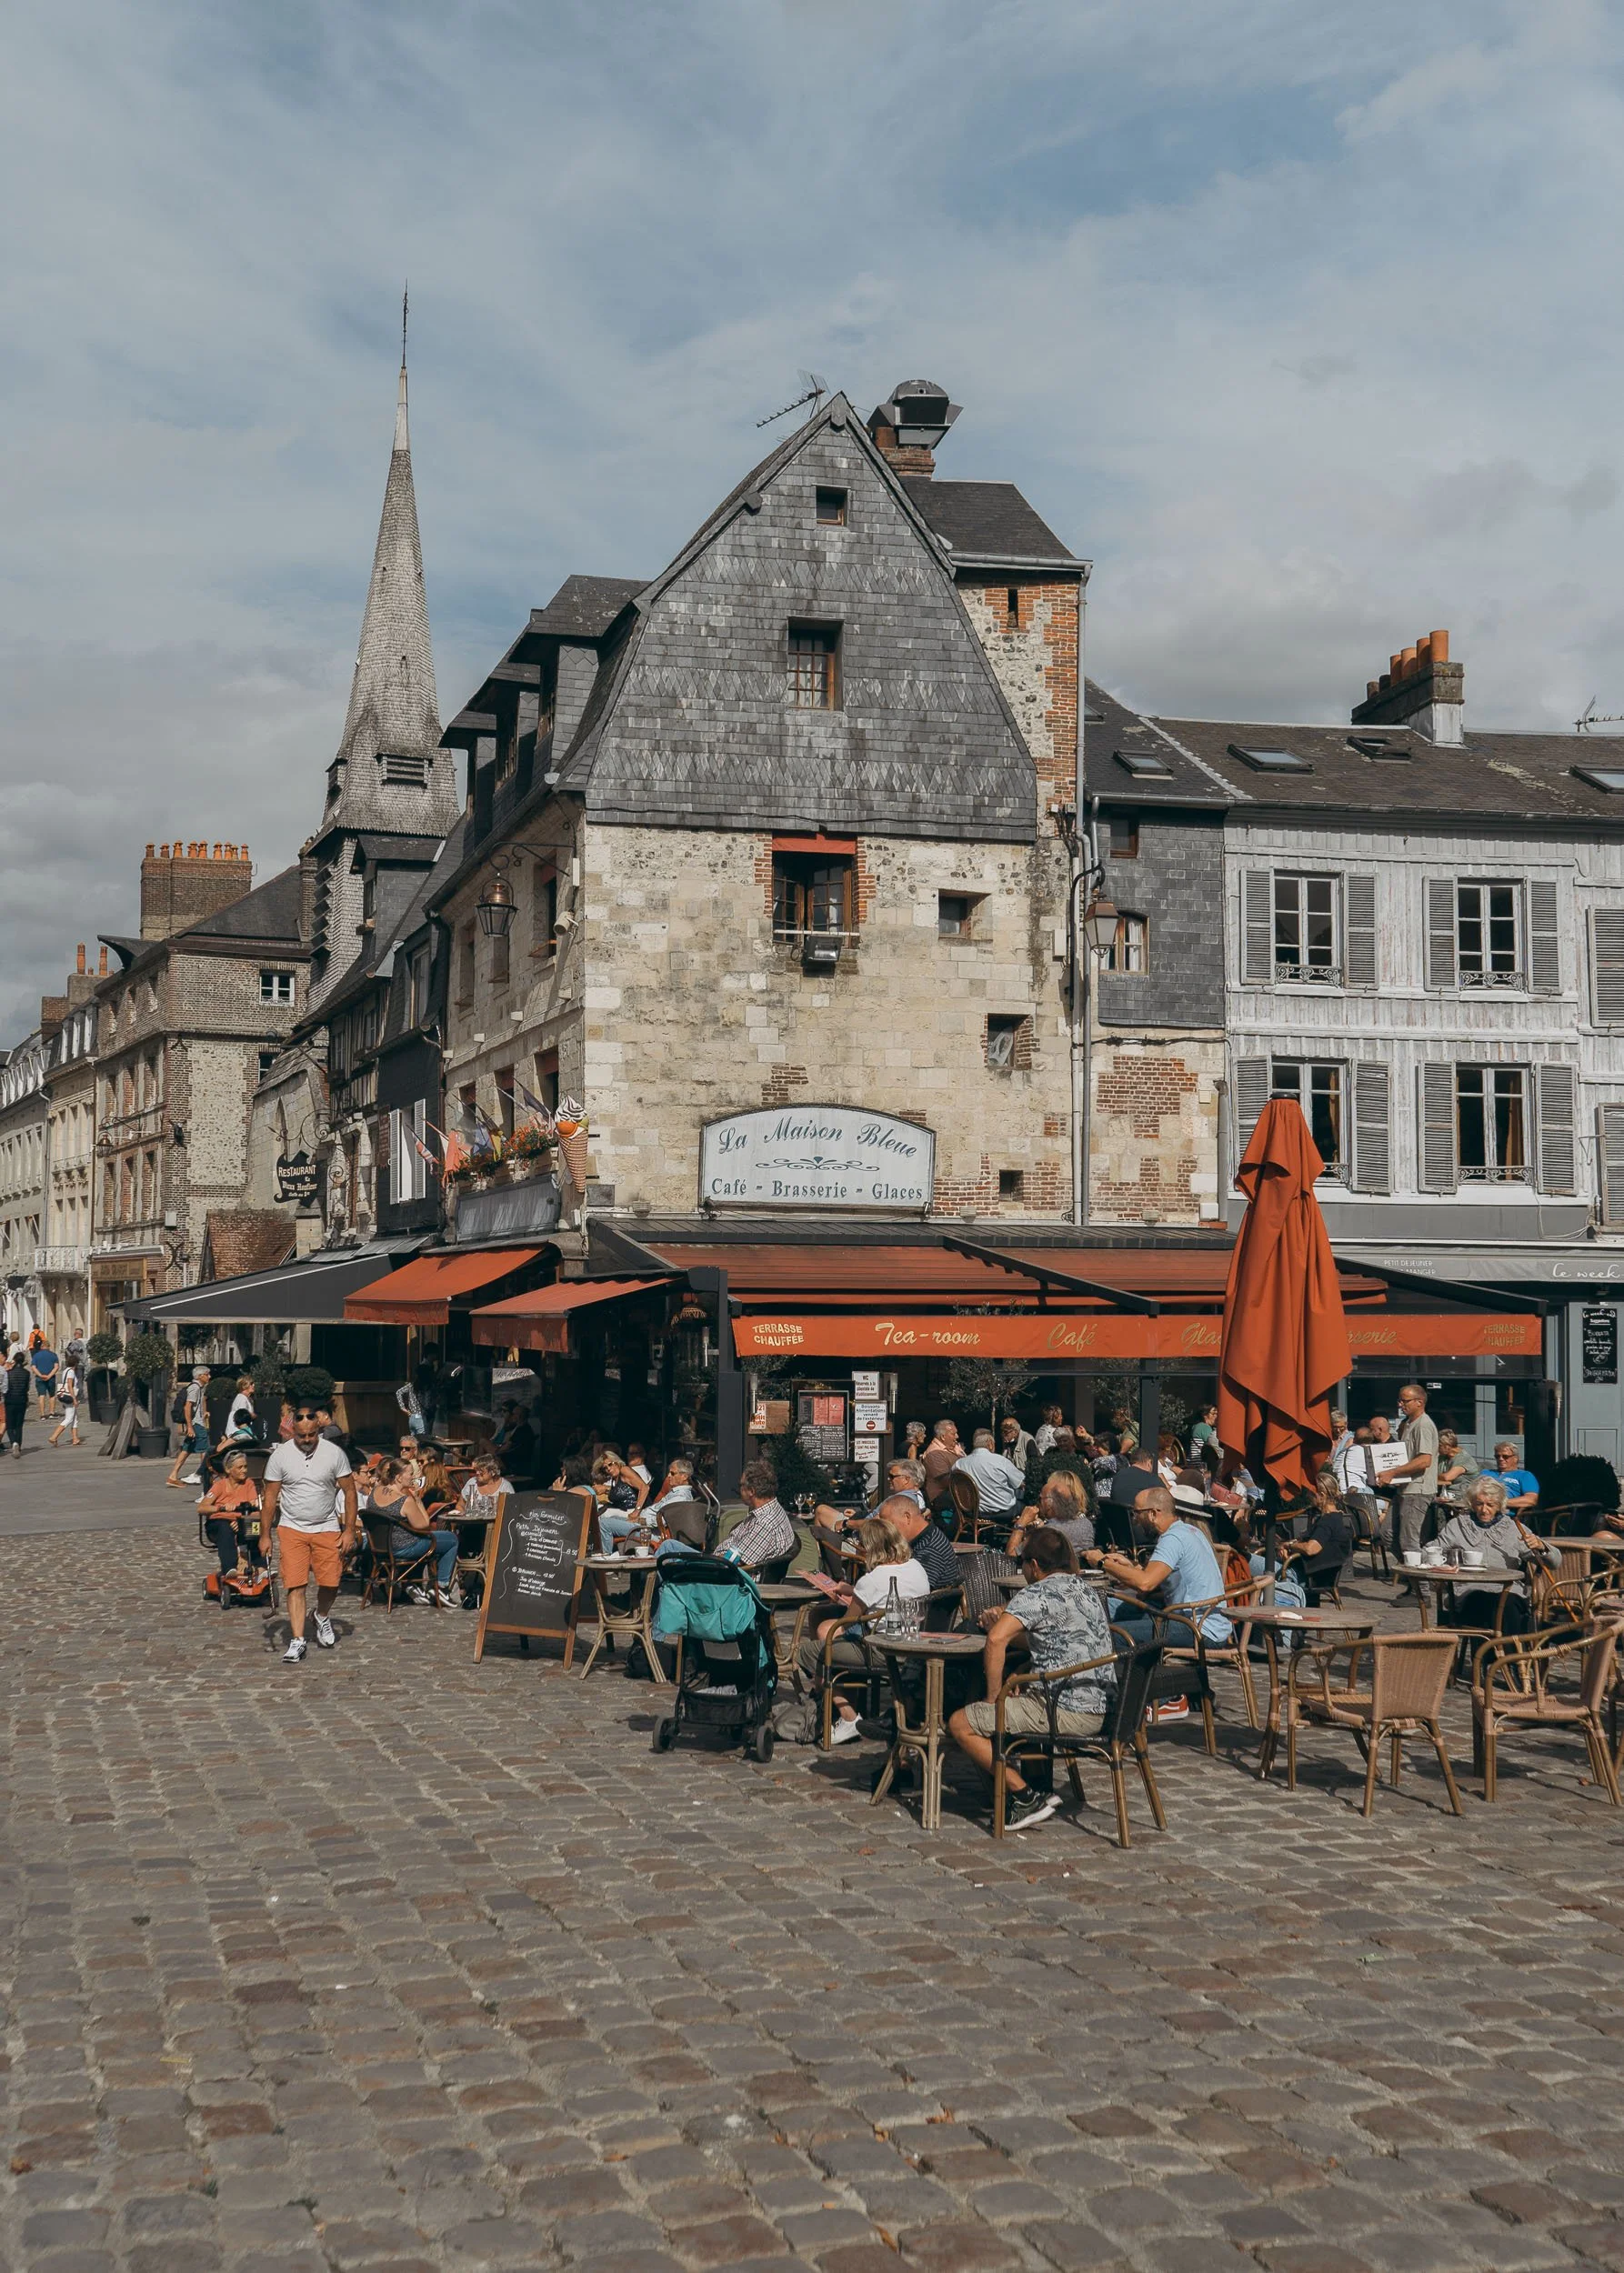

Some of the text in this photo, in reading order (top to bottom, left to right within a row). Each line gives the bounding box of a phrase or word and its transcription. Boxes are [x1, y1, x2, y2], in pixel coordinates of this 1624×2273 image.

[719, 1116, 917, 1157] La Maison Bleue
[278, 1165, 316, 1177] RESTAURANT
[712, 1178, 747, 1196] Café
[771, 1180, 847, 1198] Brasserie
[872, 1183, 923, 1201] Glaces
[752, 1324, 803, 1335] TERRASSE
[754, 1334, 805, 1347] CHAUFFÉE
[874, 1322, 981, 1346] Tea-room
[1046, 1323, 1098, 1353] Café
[1180, 1322, 1223, 1353] Glac
[1483, 1324, 1526, 1334] TERRASSE
